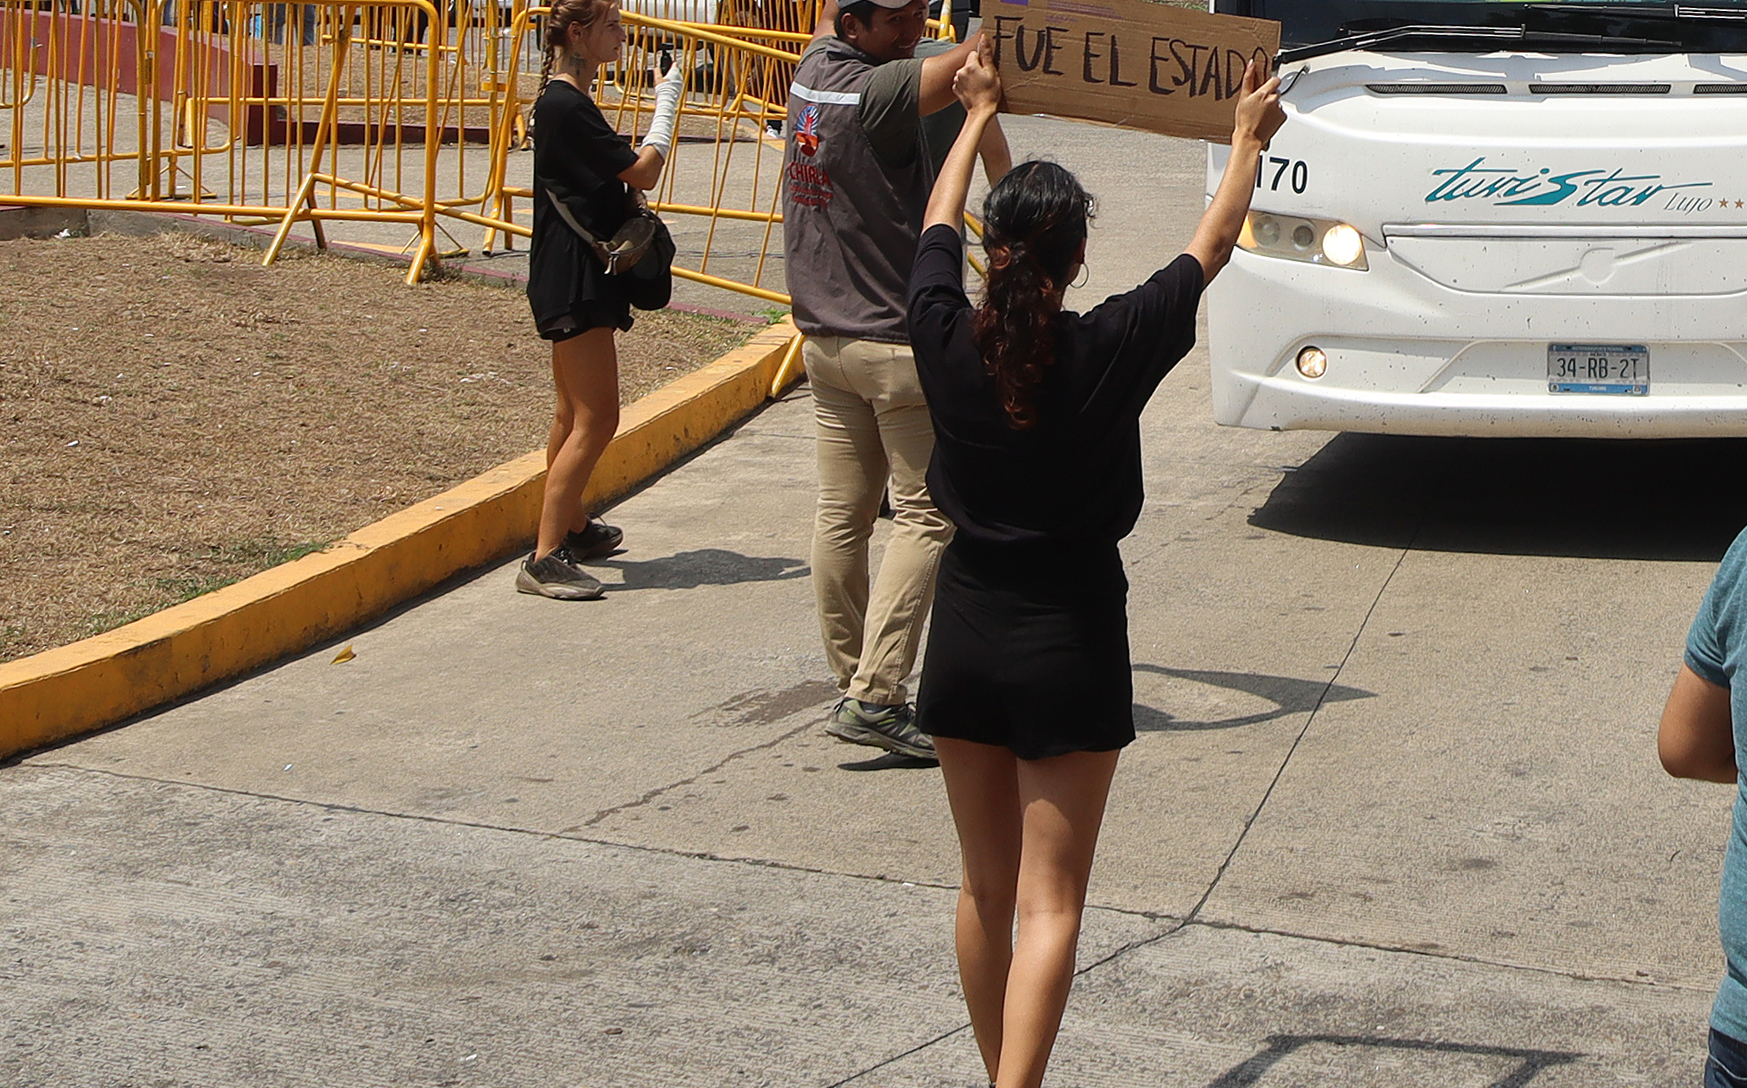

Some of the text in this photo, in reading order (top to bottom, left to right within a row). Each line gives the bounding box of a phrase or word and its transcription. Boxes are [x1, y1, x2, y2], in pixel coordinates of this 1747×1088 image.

[992, 15, 1270, 101] FUE EL ESTADO
[1663, 192, 1713, 216] Lujo
